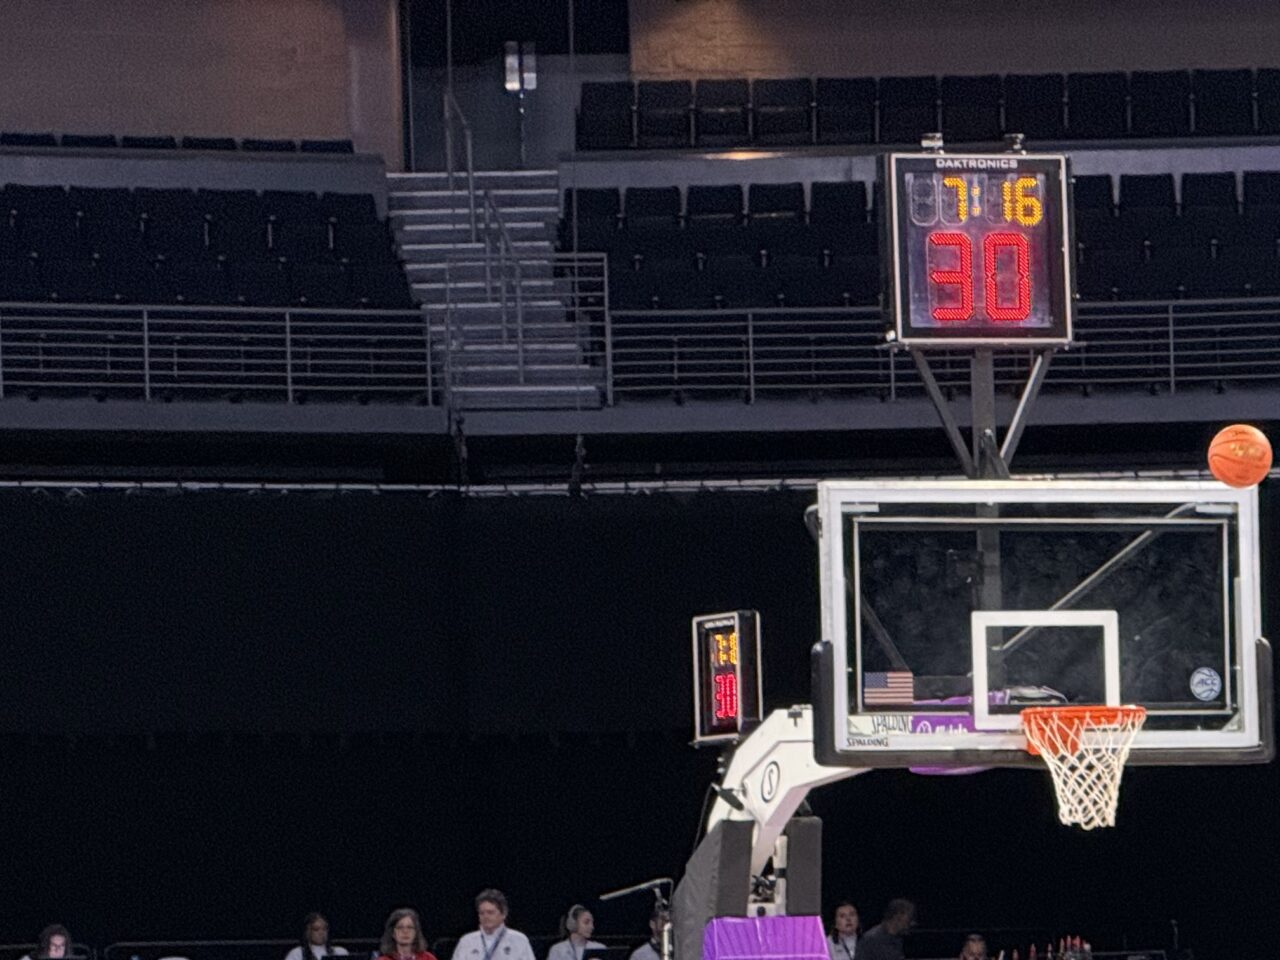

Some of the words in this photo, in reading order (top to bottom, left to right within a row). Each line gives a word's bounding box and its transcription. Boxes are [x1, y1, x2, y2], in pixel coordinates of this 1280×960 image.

[936, 159, 1018, 169] DAKTRONICS
[943, 177, 1044, 227] 7:16
[929, 233, 1031, 321] 30
[715, 673, 737, 719] 30
[847, 737, 889, 748] SPALDING
